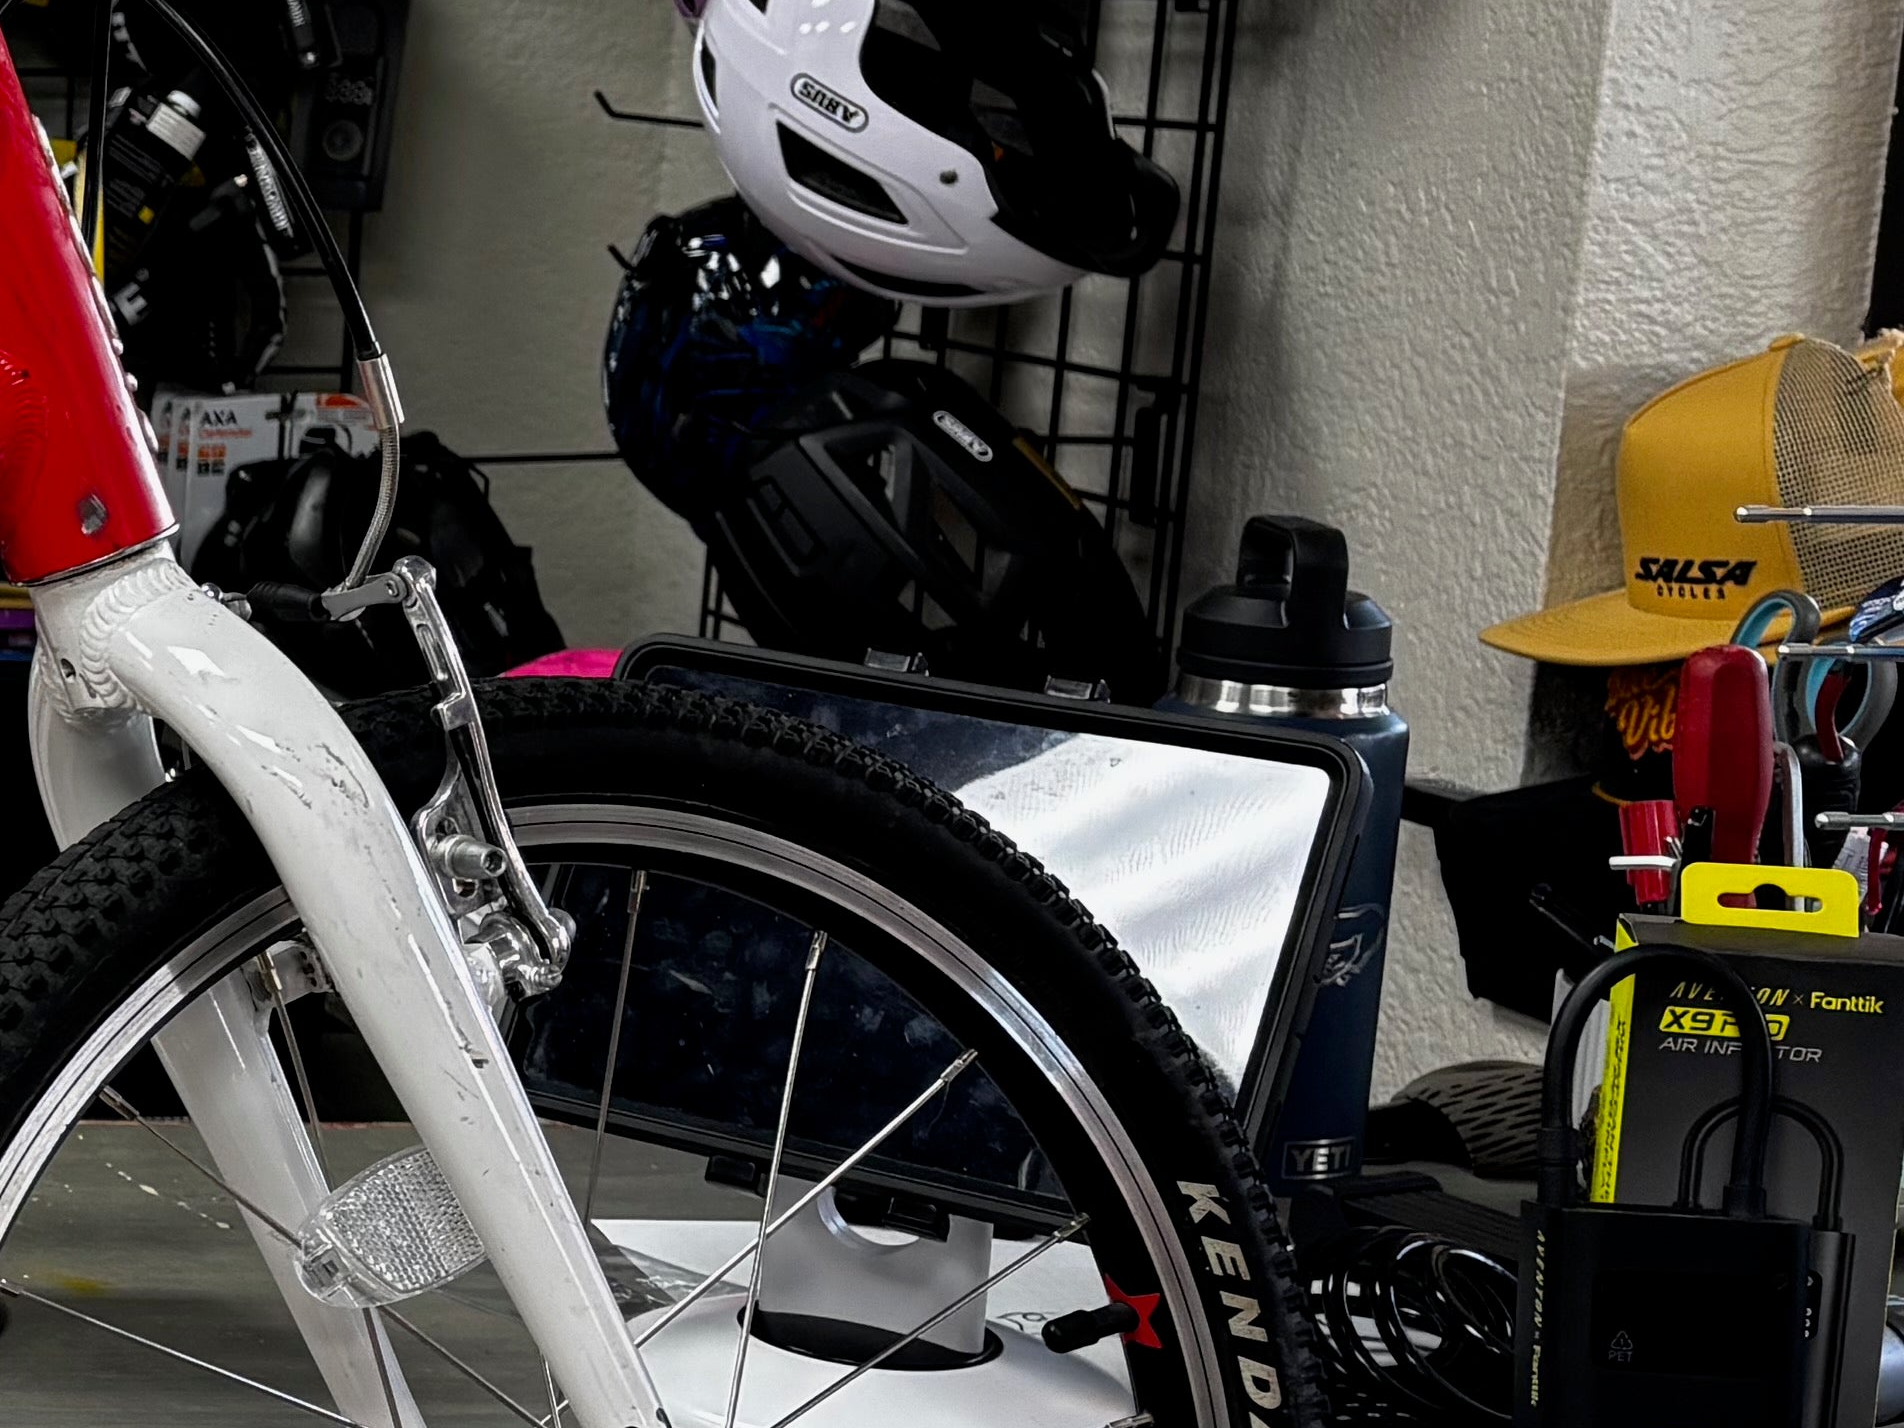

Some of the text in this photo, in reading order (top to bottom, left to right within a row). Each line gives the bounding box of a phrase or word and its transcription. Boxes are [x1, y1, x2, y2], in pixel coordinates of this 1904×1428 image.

[796, 79, 860, 125] ABUS
[200, 409, 239, 428] AXA
[1635, 557, 1758, 586] SALSA
[1656, 585, 1726, 600] CYCLES
[1668, 982, 1885, 1015] AVEON Fanttik
[1664, 1007, 1715, 1033] X9
[1658, 1037, 1823, 1065] AIR INFTOR
[1291, 1145, 1353, 1176] YETI
[1607, 1350, 1634, 1363] PET
